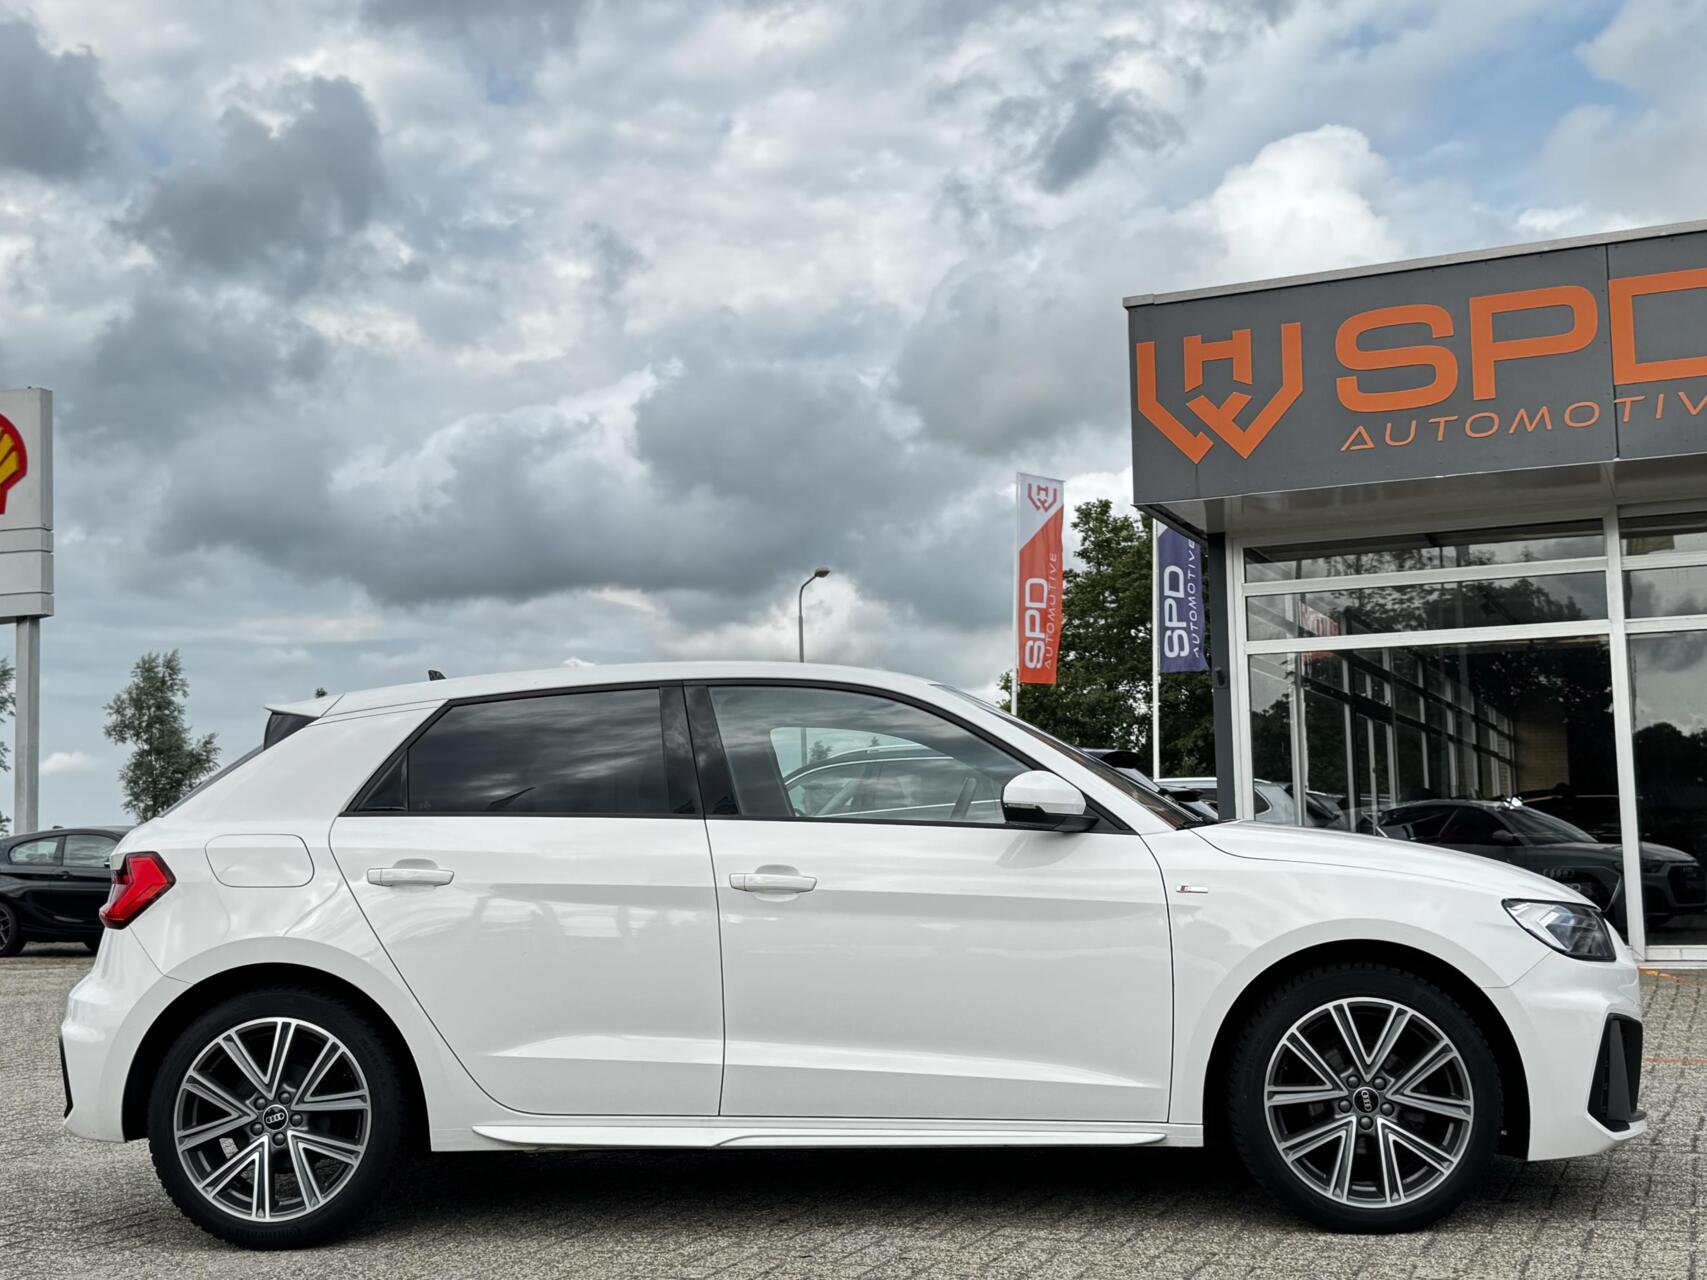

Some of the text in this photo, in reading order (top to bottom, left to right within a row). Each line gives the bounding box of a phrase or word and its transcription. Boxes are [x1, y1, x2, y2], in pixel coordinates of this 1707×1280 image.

[1024, 577, 1048, 669] SPD
[1044, 552, 1057, 670] AUTOMOTIVE
[1163, 565, 1190, 658] SPD
[1187, 539, 1201, 658] AUTOMOTIVE
